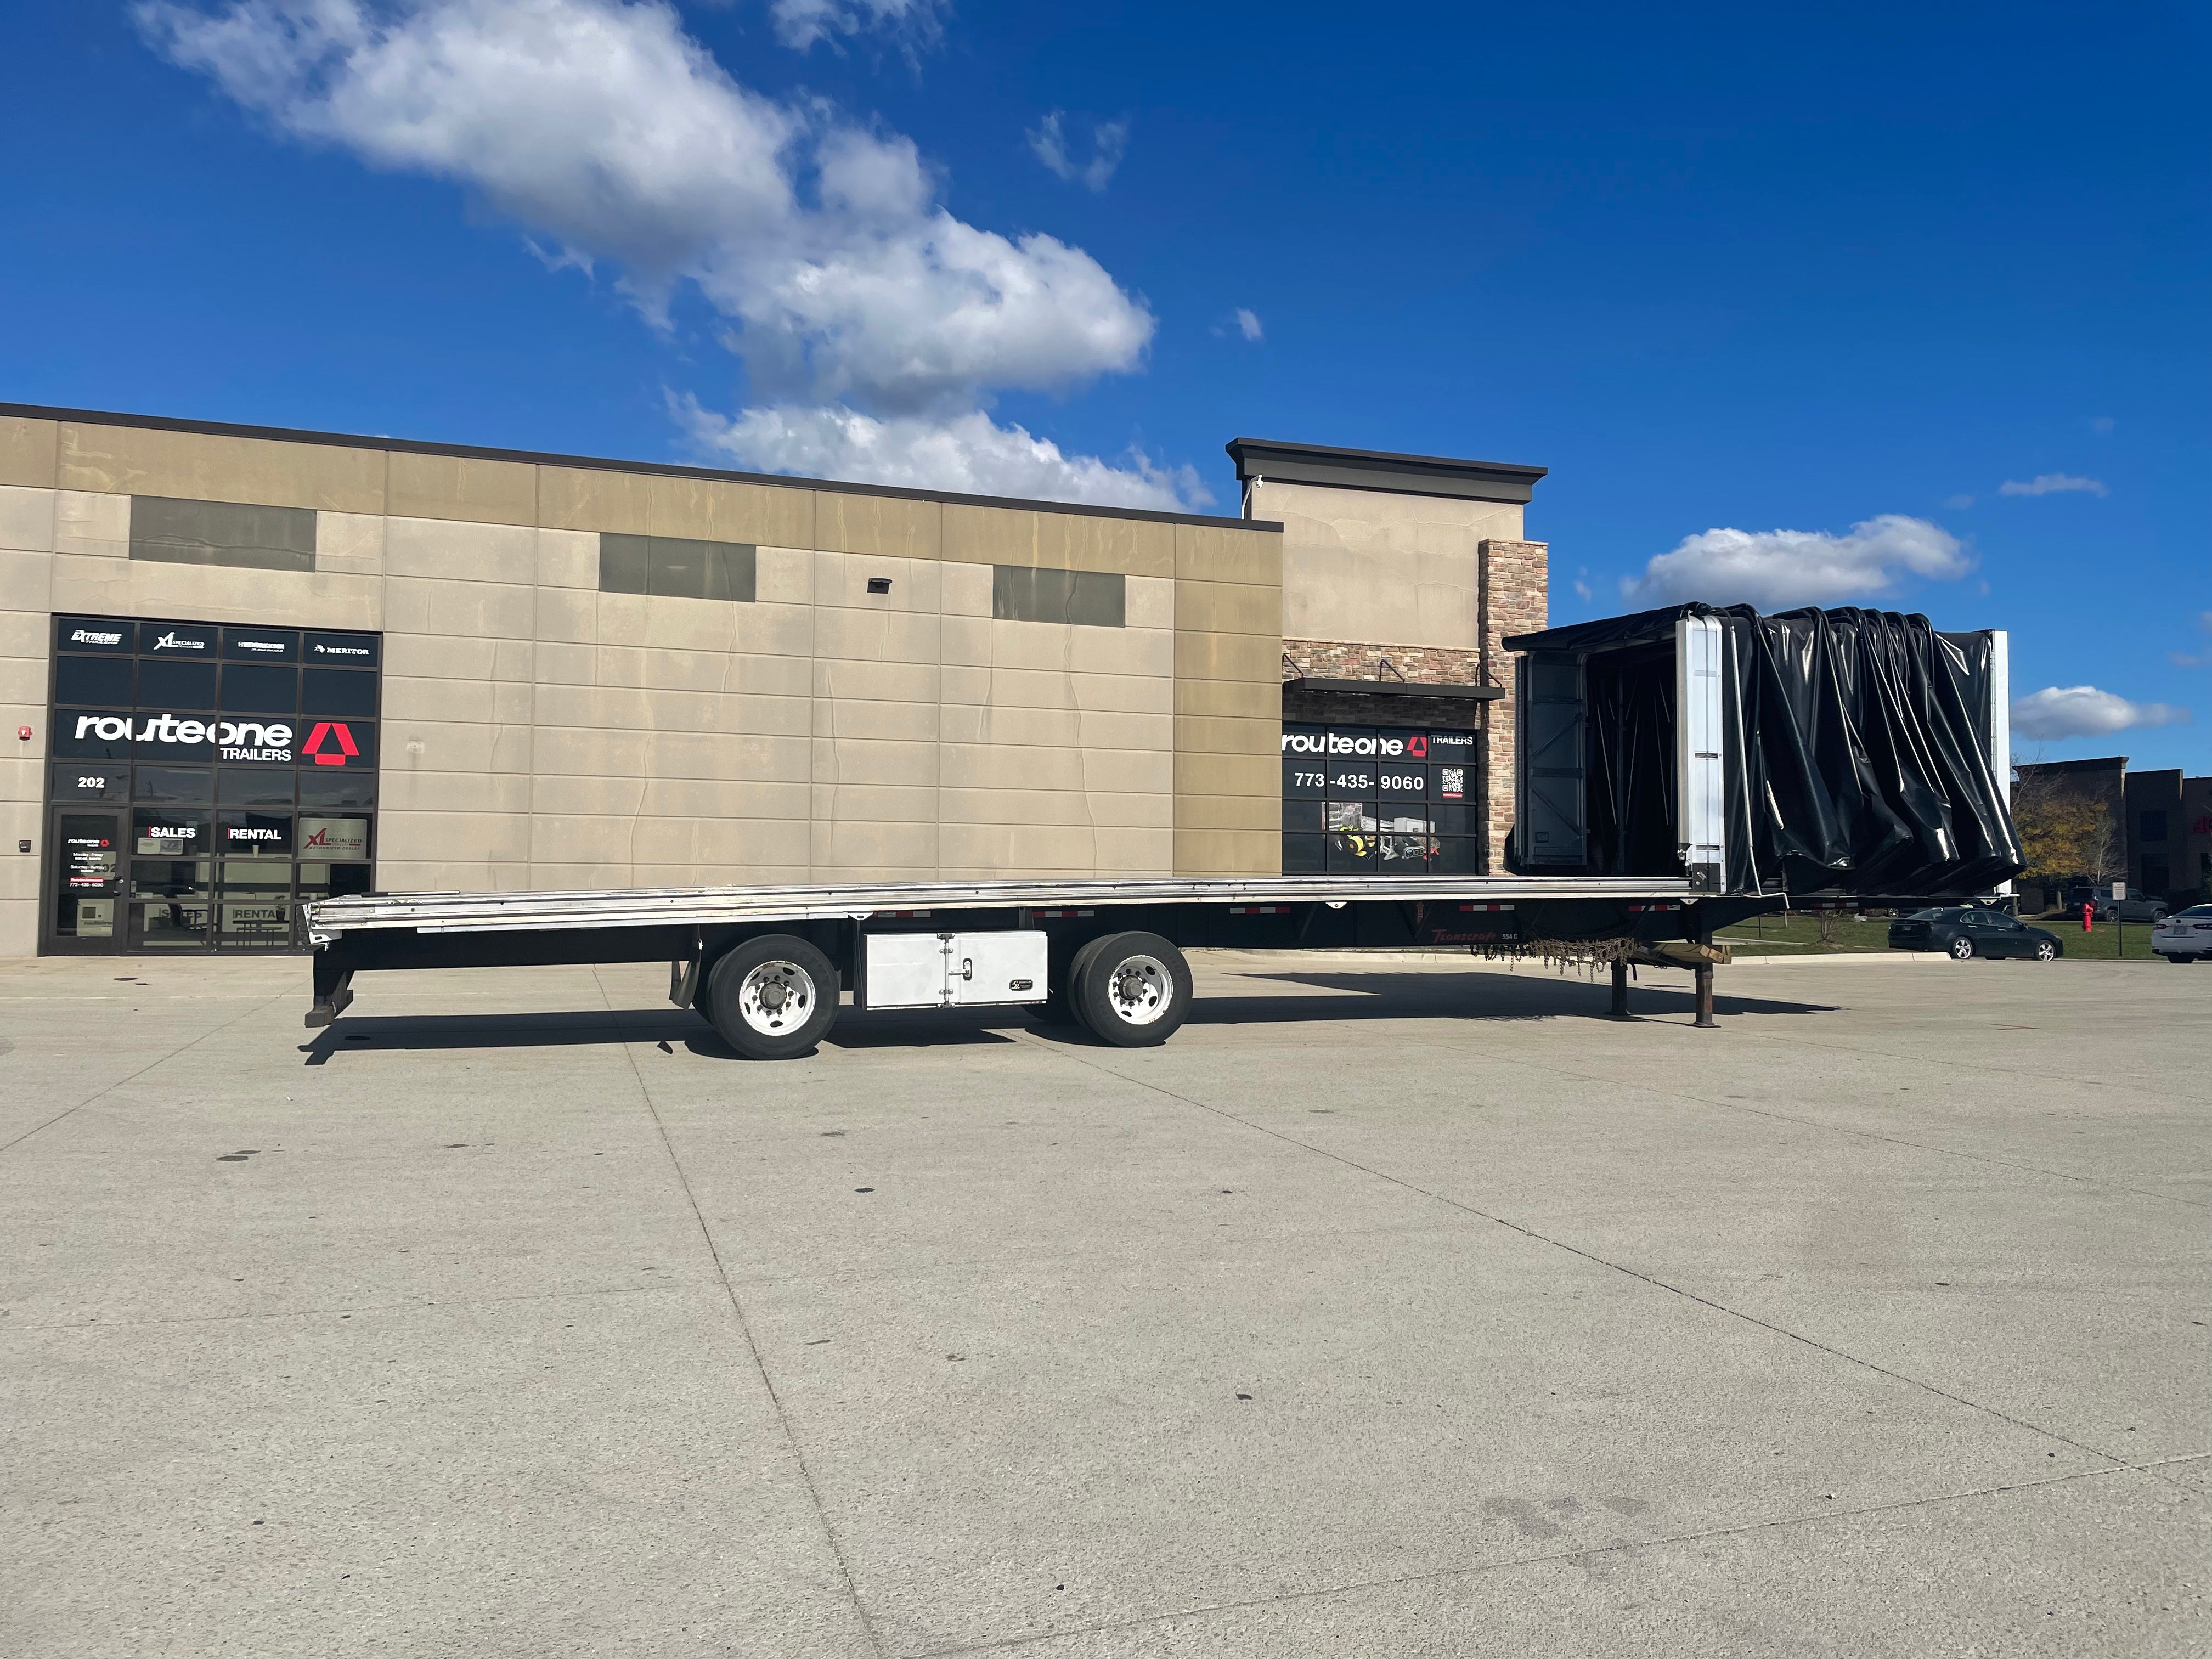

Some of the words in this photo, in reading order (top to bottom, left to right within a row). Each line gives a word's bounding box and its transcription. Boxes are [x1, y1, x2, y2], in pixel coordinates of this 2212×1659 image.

[71, 629, 122, 642] EXTREME
[153, 631, 178, 650] XL
[327, 647, 369, 655] MERITOR
[75, 714, 292, 747] routeone
[1282, 733, 1403, 755] routeone
[1431, 735, 1473, 746] TRAILERS
[220, 747, 292, 761] TRAILERS
[78, 776, 105, 788] 202
[151, 827, 196, 838] SALES
[230, 828, 282, 840] RENTAL
[303, 827, 331, 849] XL
